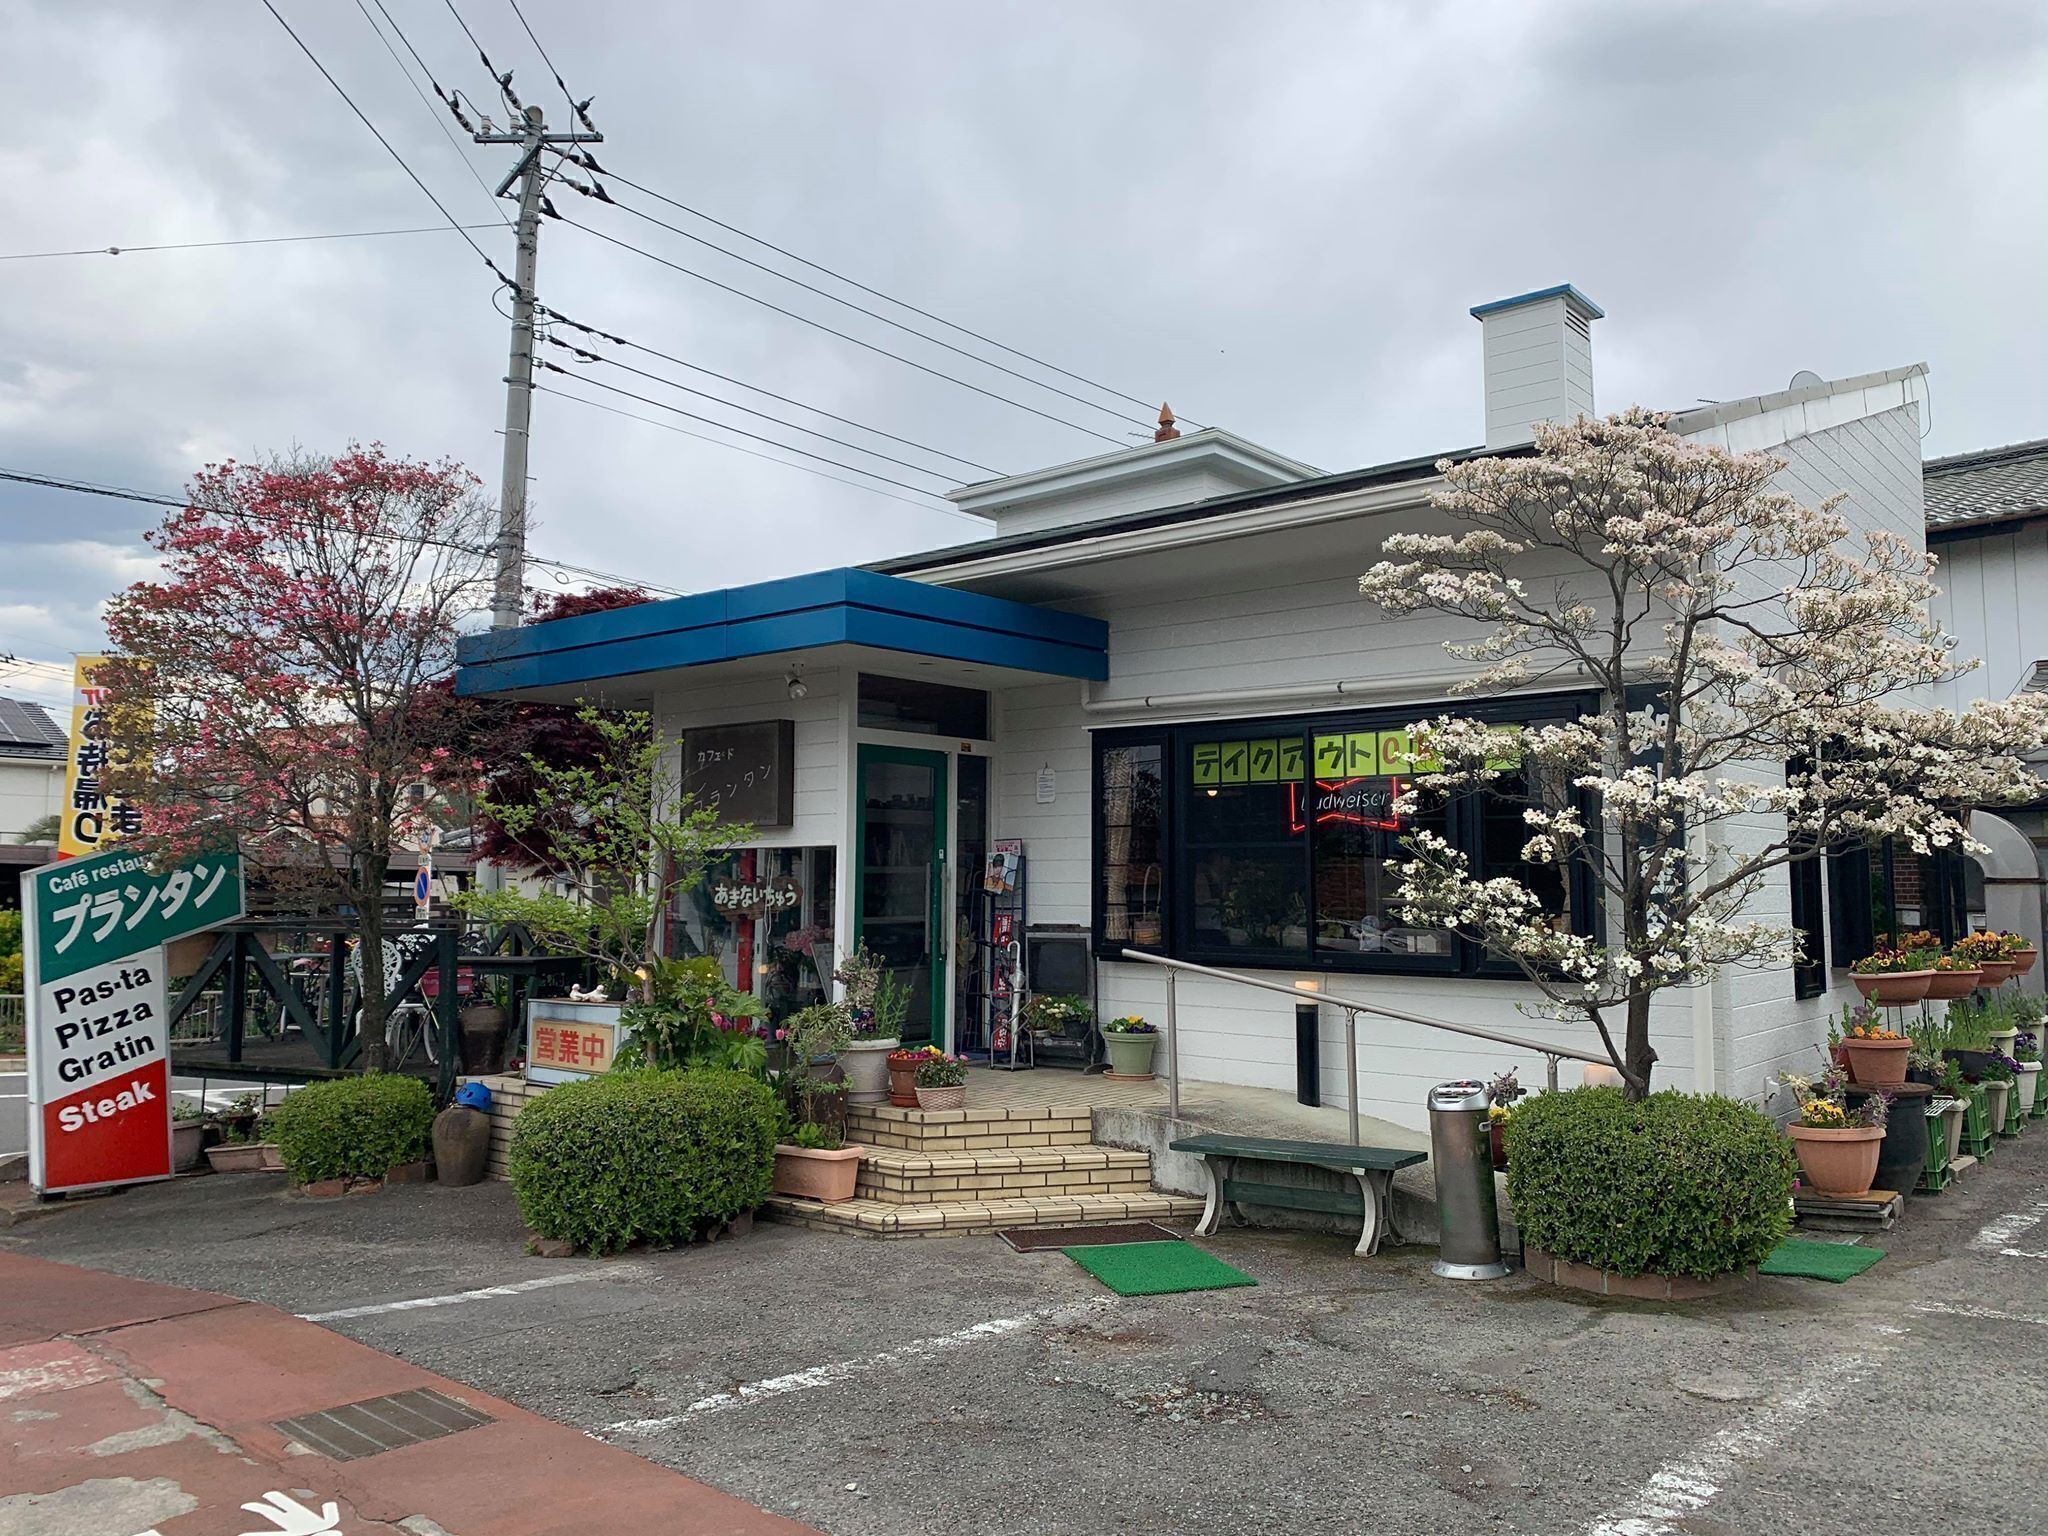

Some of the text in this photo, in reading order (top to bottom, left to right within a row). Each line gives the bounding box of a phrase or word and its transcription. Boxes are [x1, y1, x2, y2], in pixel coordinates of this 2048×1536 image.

[48, 855, 147, 894] Café restau
[714, 882, 797, 909] あきないちゅう
[53, 863, 227, 955] プランタン
[55, 1001, 154, 1050] Pizza
[535, 1027, 605, 1067] 営業中
[58, 1035, 155, 1083] Gratin
[58, 1080, 156, 1132] Steak
